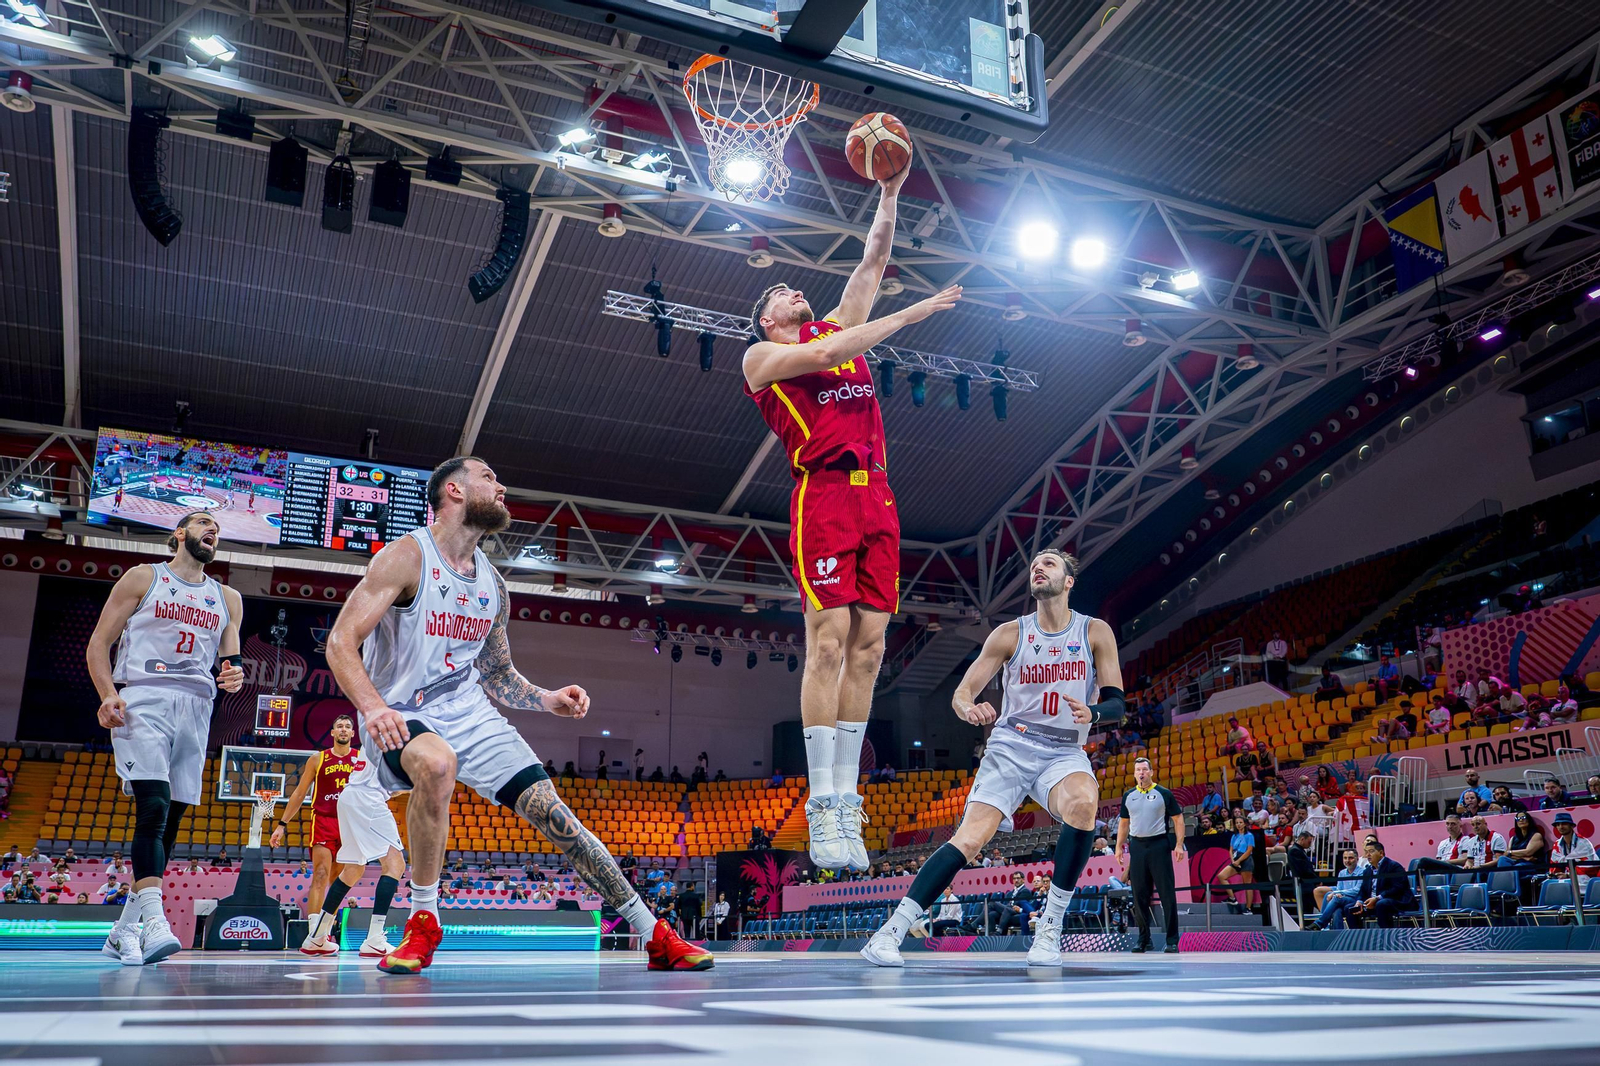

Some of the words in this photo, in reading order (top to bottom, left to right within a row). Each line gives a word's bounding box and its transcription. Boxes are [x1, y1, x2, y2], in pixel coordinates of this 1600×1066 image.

[818, 382, 874, 404] endes
[304, 457, 330, 465] GEORGIA
[339, 486, 353, 497] 32
[371, 490, 384, 500] 31
[350, 501, 372, 512] 1:30
[342, 524, 376, 533] TIME-OUTS
[176, 631, 195, 654] 23
[445, 653, 455, 672] 5
[270, 700, 288, 709] 1:29
[1042, 692, 1059, 716] 10
[267, 711, 286, 727] 11
[1444, 729, 1586, 771] LIMASSOL
[335, 778, 346, 788] 14
[325, 792, 340, 801] end
[230, 920, 259, 928] 百岁山
